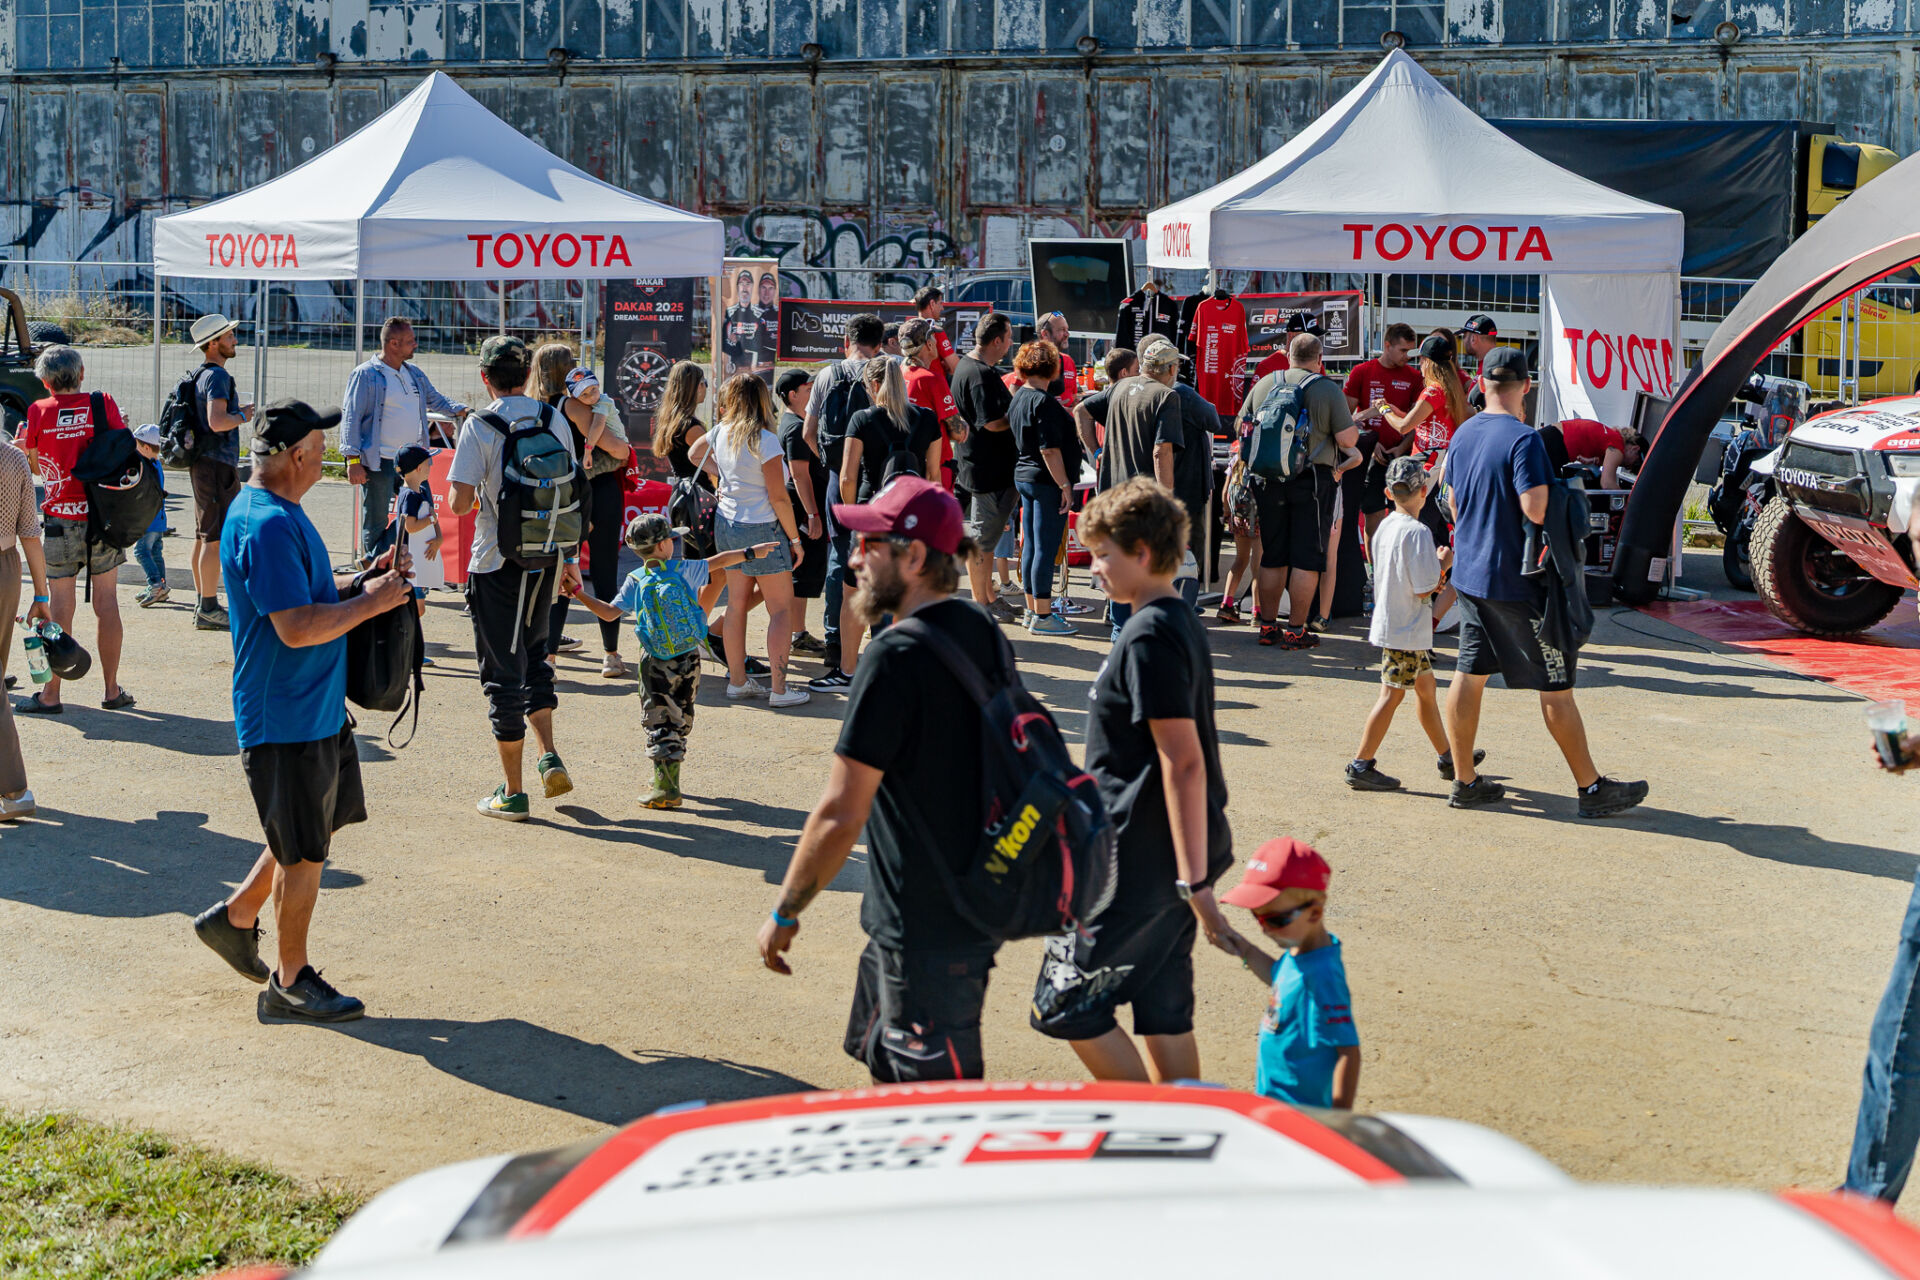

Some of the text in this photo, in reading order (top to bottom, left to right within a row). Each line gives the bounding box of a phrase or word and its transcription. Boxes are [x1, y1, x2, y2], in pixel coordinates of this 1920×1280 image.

[1163, 222, 1192, 257] TOYOTA
[1343, 223, 1553, 261] TOYOTA
[206, 233, 299, 268] TOYOTA
[467, 233, 633, 268] TOYOTA
[636, 278, 664, 286] DAKAR
[614, 302, 684, 312] DAKAR 2025
[1251, 314, 1277, 325] GR
[823, 324, 846, 334] DAT
[59, 413, 87, 425] GR
[1812, 421, 1860, 434] Czech
[56, 430, 86, 439] Czech
[1780, 467, 1818, 490] TOYOTA
[1807, 519, 1888, 550] TOYOTA
[790, 1110, 1114, 1134] Czech
